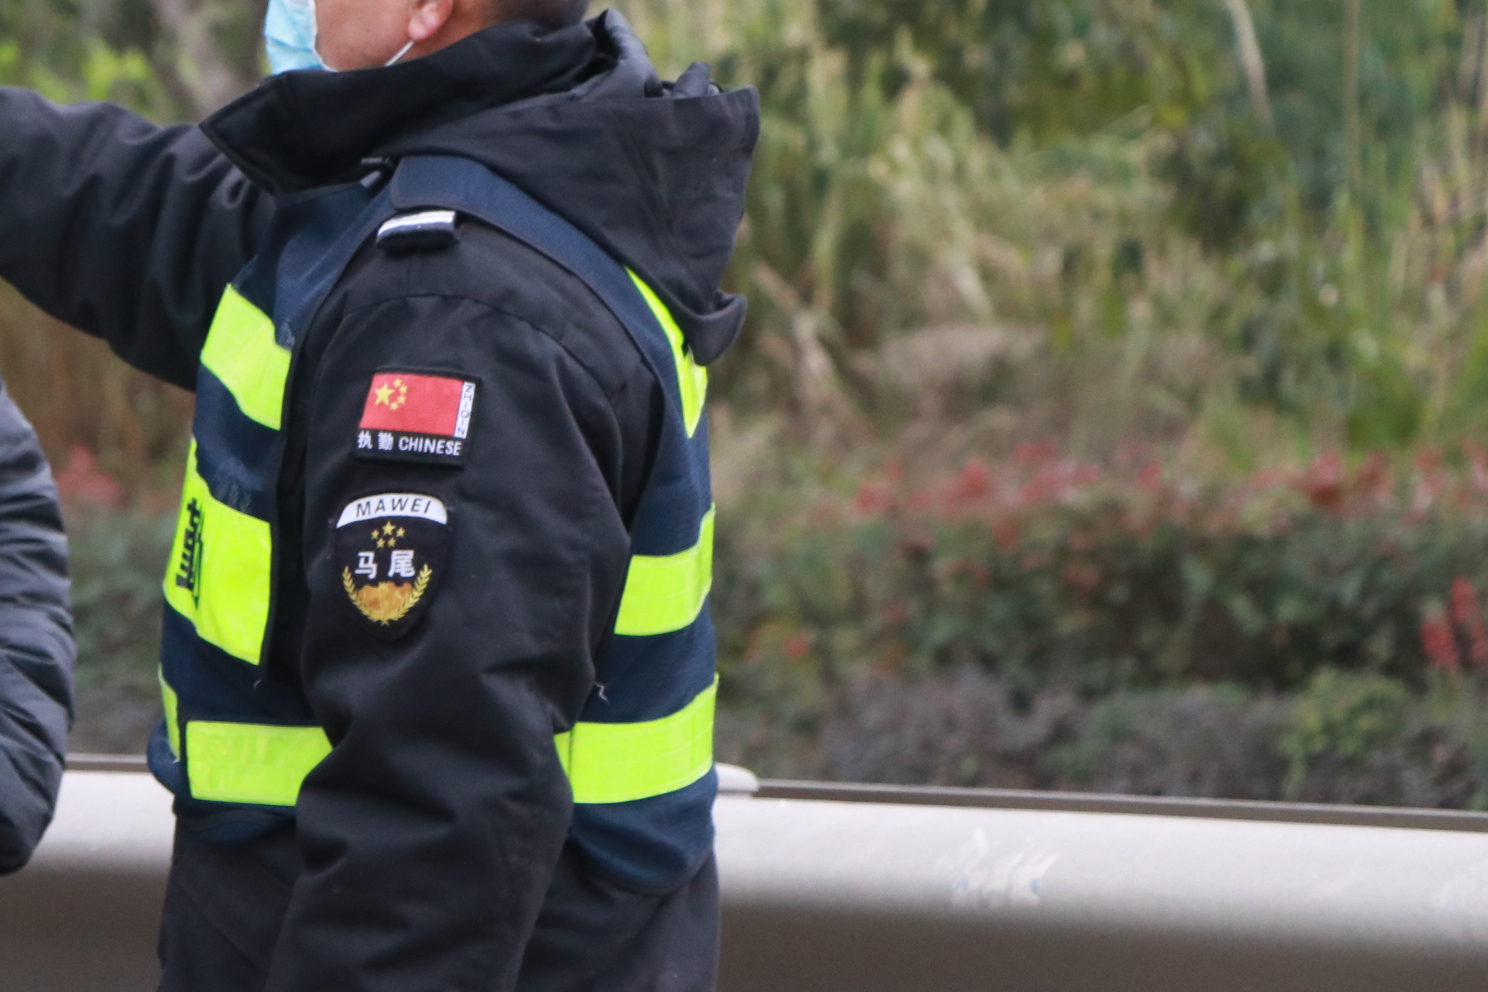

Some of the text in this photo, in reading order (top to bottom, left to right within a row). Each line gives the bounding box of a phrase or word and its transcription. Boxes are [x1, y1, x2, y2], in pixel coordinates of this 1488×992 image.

[357, 430, 463, 456] 执勤 CHINESE
[355, 497, 432, 519] MAWEI
[354, 549, 416, 580] 马尾
